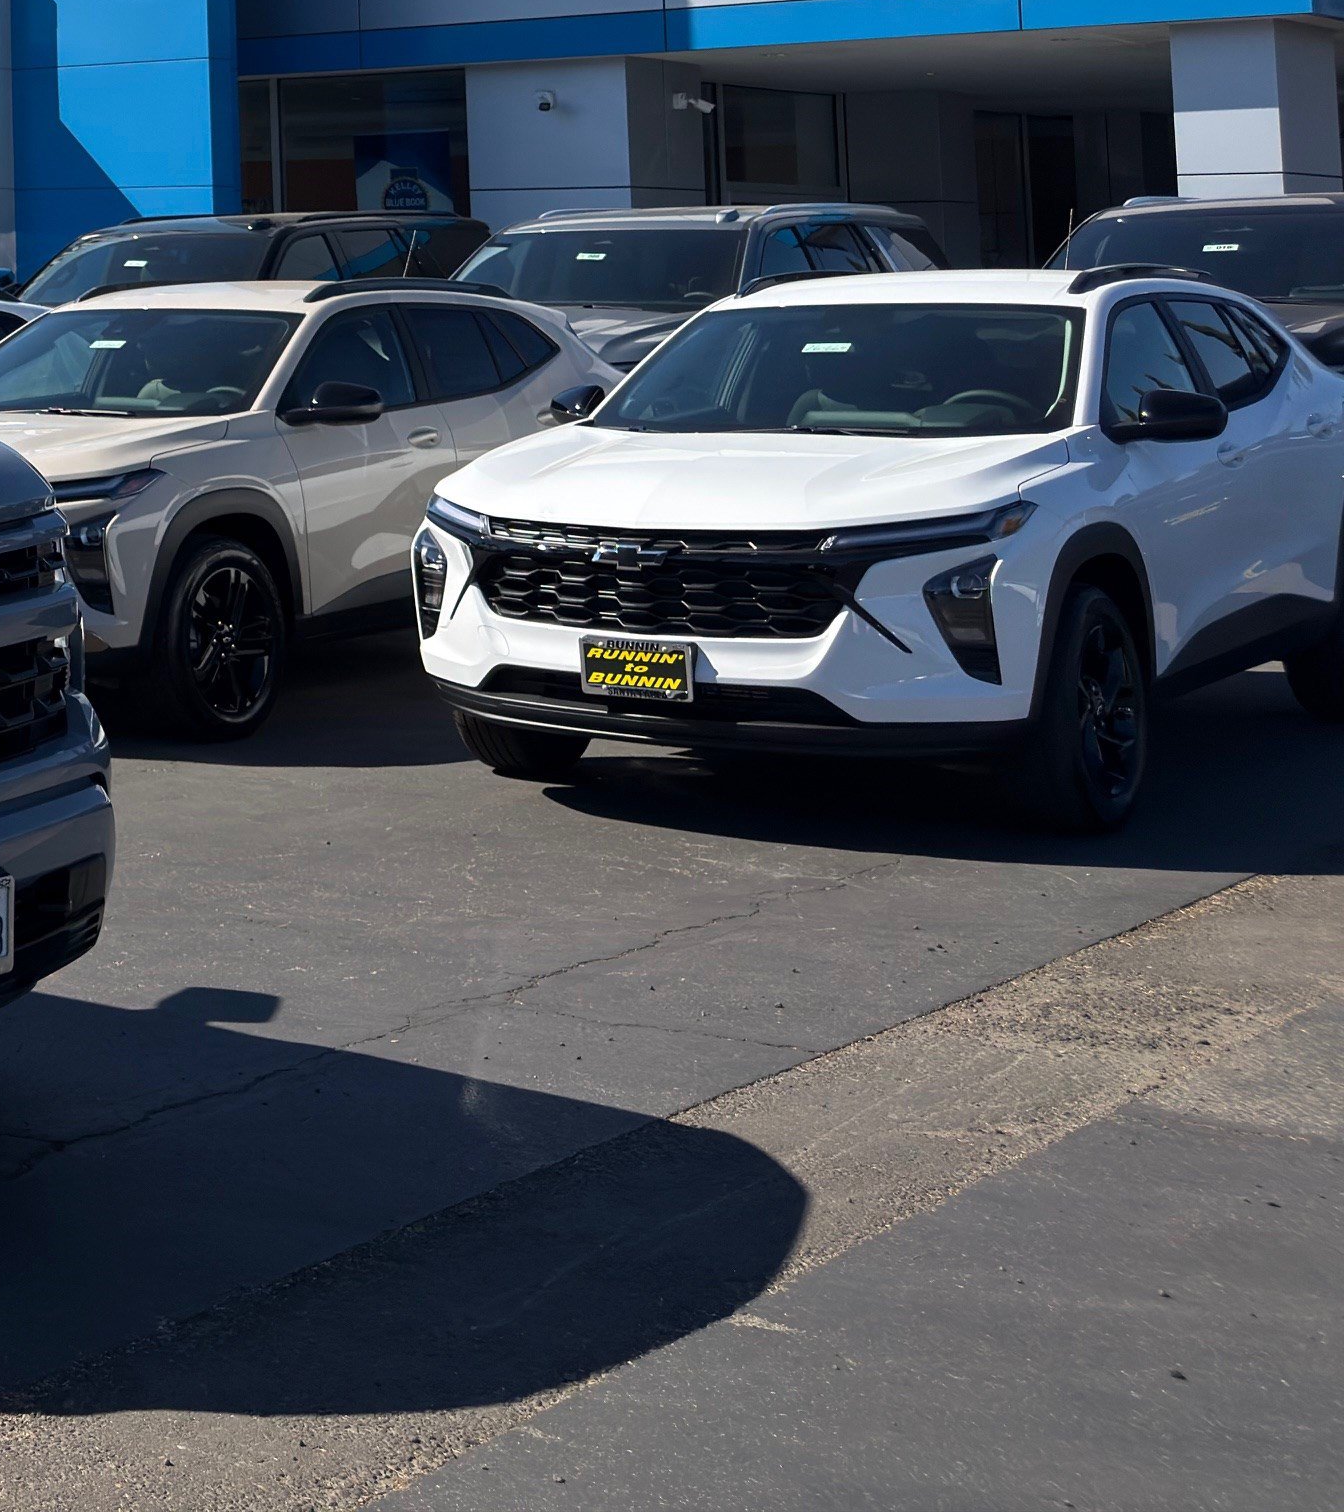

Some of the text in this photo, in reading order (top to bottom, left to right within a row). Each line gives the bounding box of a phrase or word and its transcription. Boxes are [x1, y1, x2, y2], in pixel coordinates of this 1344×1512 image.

[606, 640, 660, 651] BUNNIN
[586, 647, 684, 664] RUNNIN'
[624, 663, 649, 673] to
[587, 671, 682, 690] BUNNIN
